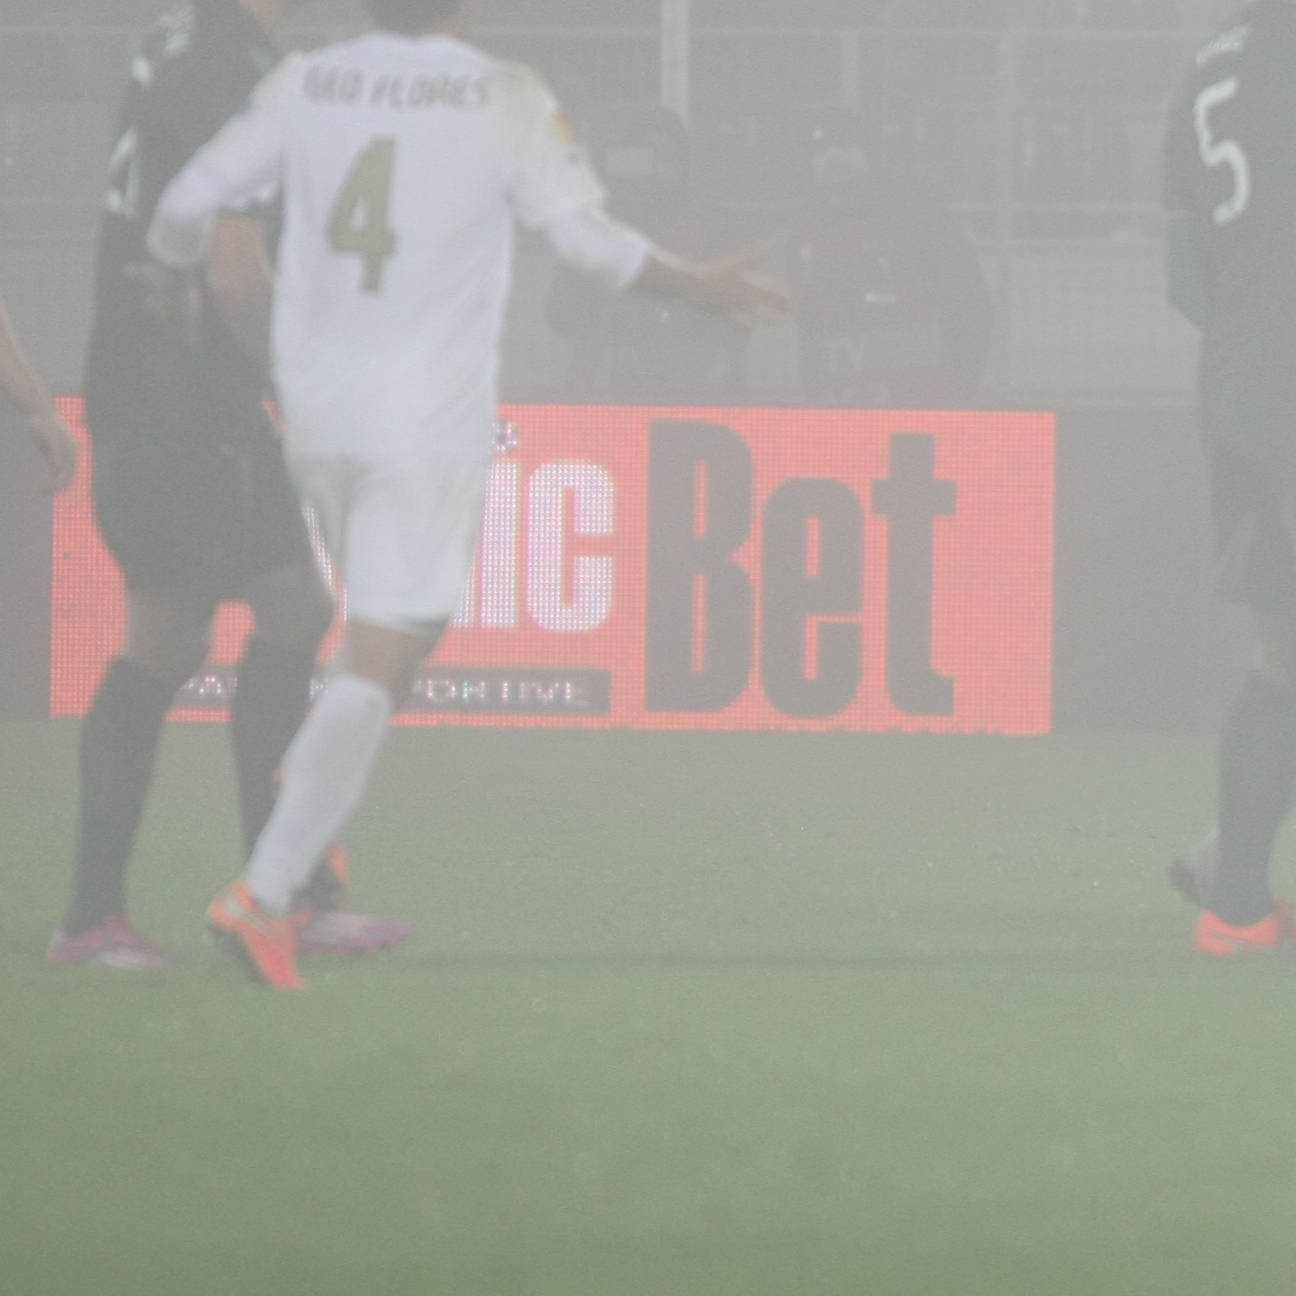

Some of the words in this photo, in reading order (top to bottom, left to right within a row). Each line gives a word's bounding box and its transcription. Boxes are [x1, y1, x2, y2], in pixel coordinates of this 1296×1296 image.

[370, 71, 491, 111] FLORES
[1192, 76, 1252, 226] 5
[328, 133, 400, 292] 4
[646, 417, 958, 720] Bet
[412, 675, 591, 708] ORTIVE
